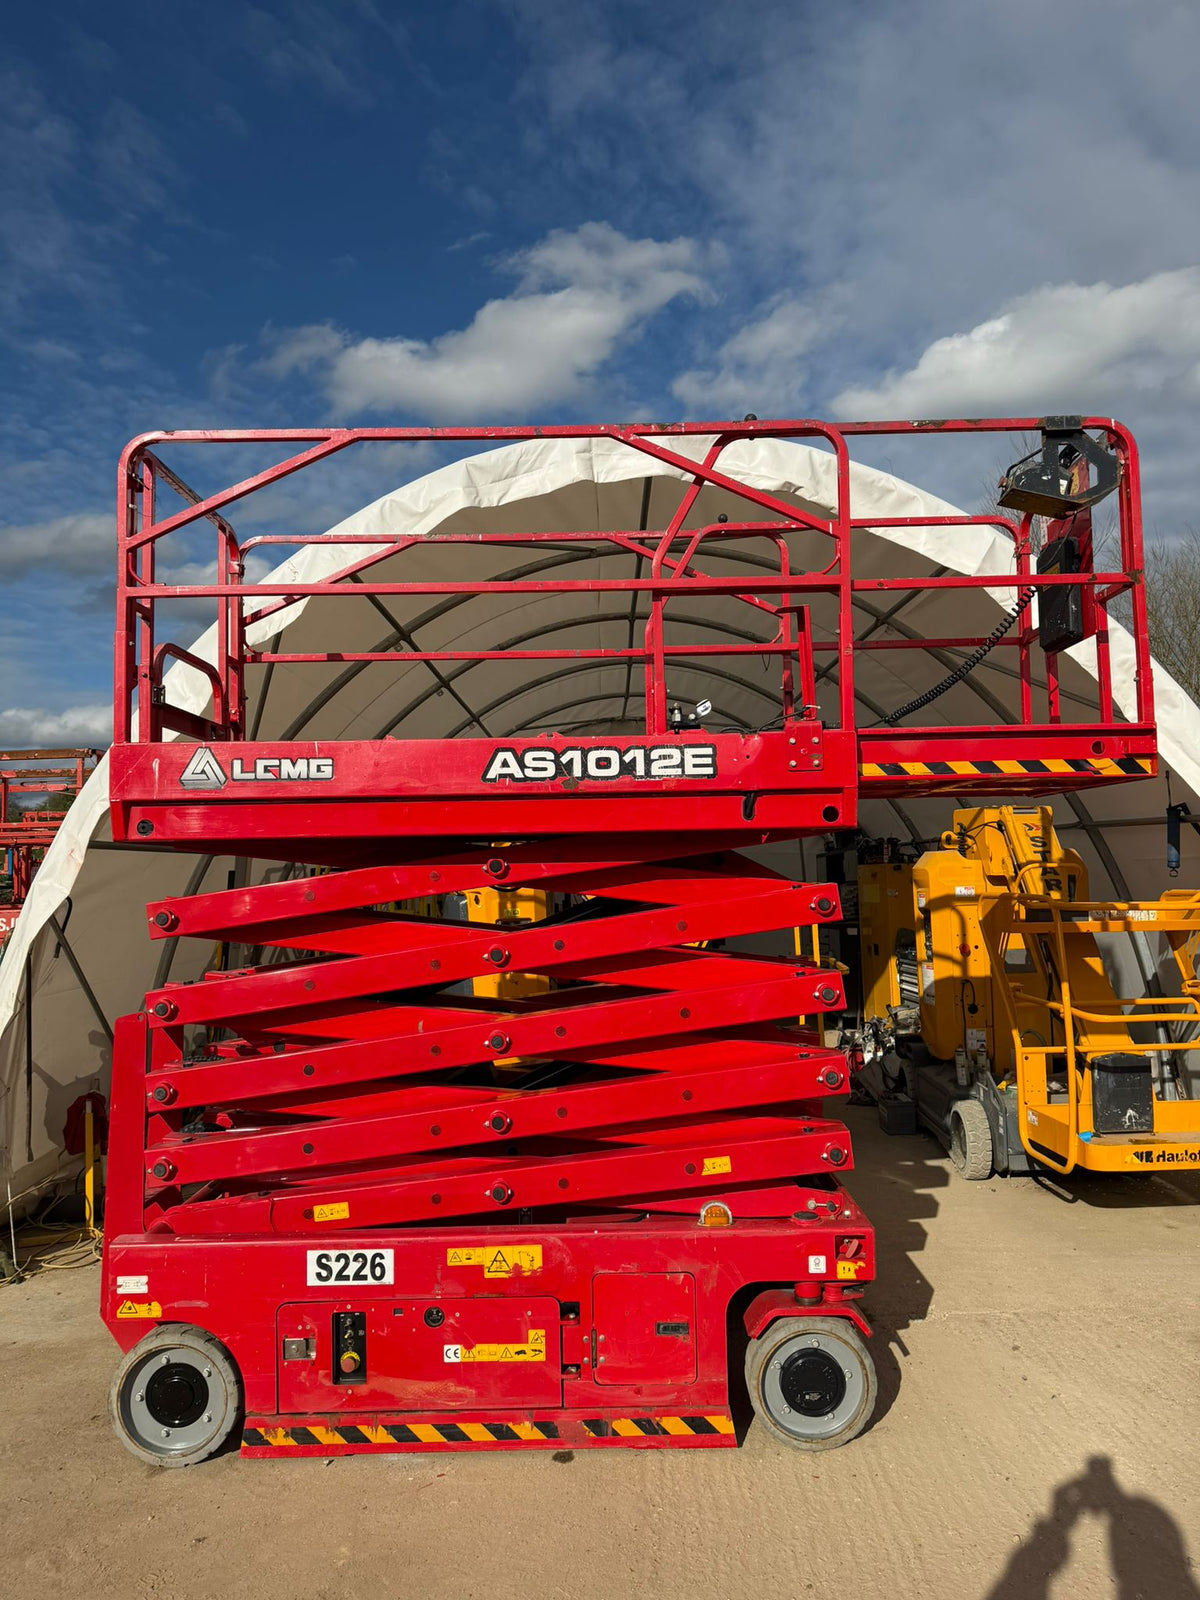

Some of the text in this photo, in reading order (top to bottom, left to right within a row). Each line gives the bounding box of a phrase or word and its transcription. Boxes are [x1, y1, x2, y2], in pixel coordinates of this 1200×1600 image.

[483, 745, 716, 781] AS1012E
[315, 1252, 386, 1282] S226
[445, 1348, 460, 1359] CE
